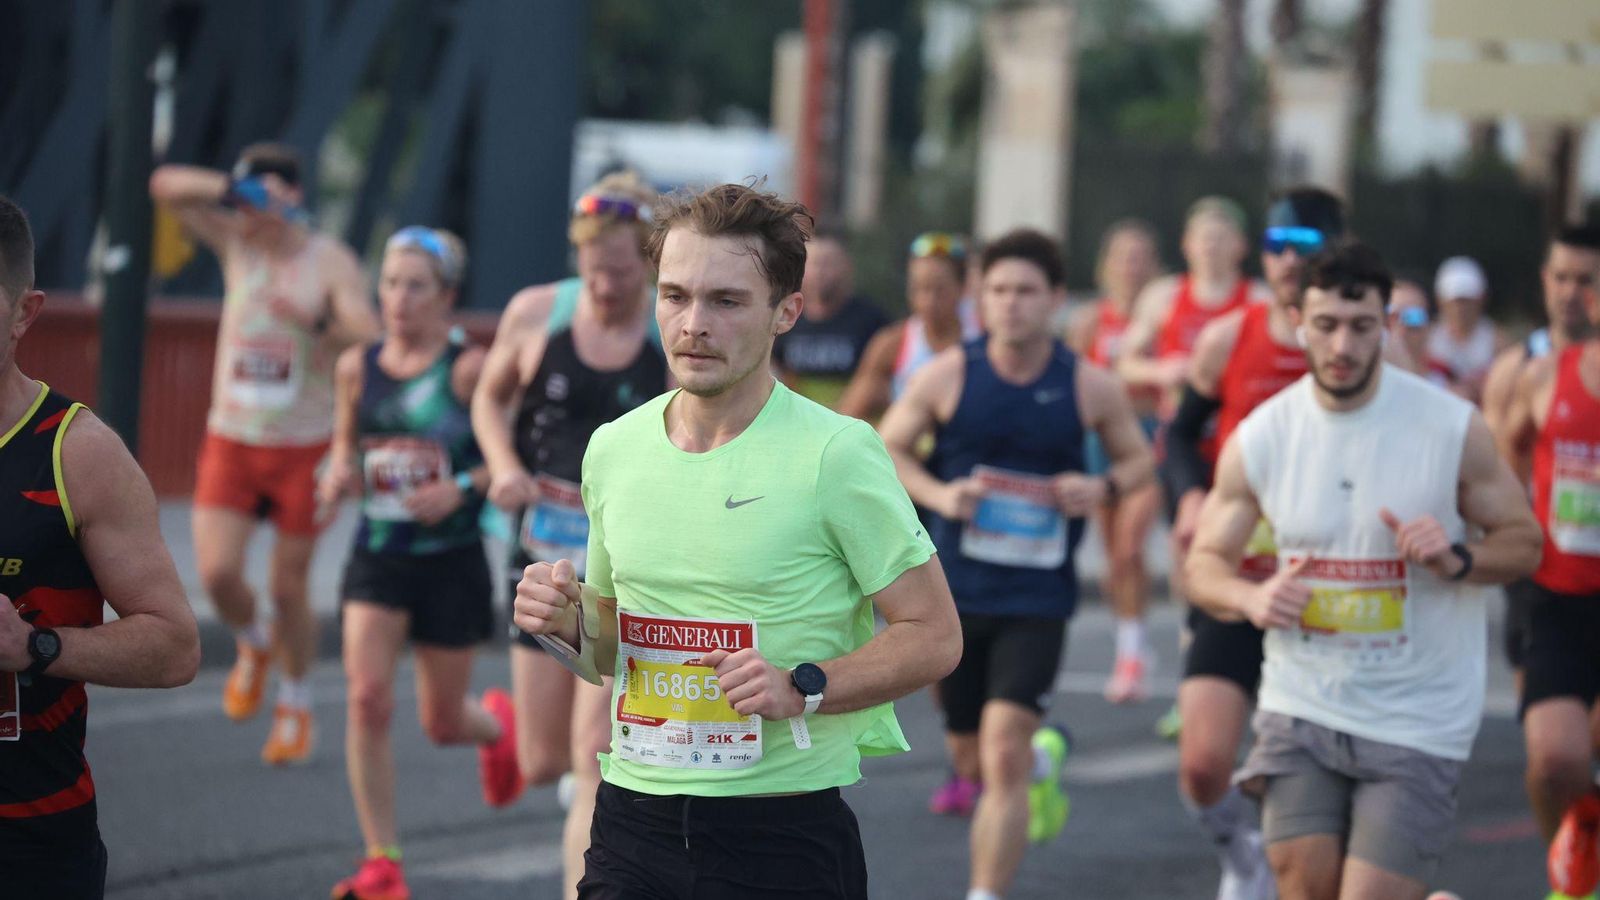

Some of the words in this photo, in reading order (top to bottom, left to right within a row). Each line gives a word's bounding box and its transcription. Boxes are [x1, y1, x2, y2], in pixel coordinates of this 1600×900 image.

[645, 624, 742, 649] GENERALI
[641, 670, 721, 701] 16865
[707, 734, 733, 744] 21K
[729, 753, 752, 762] renfe
